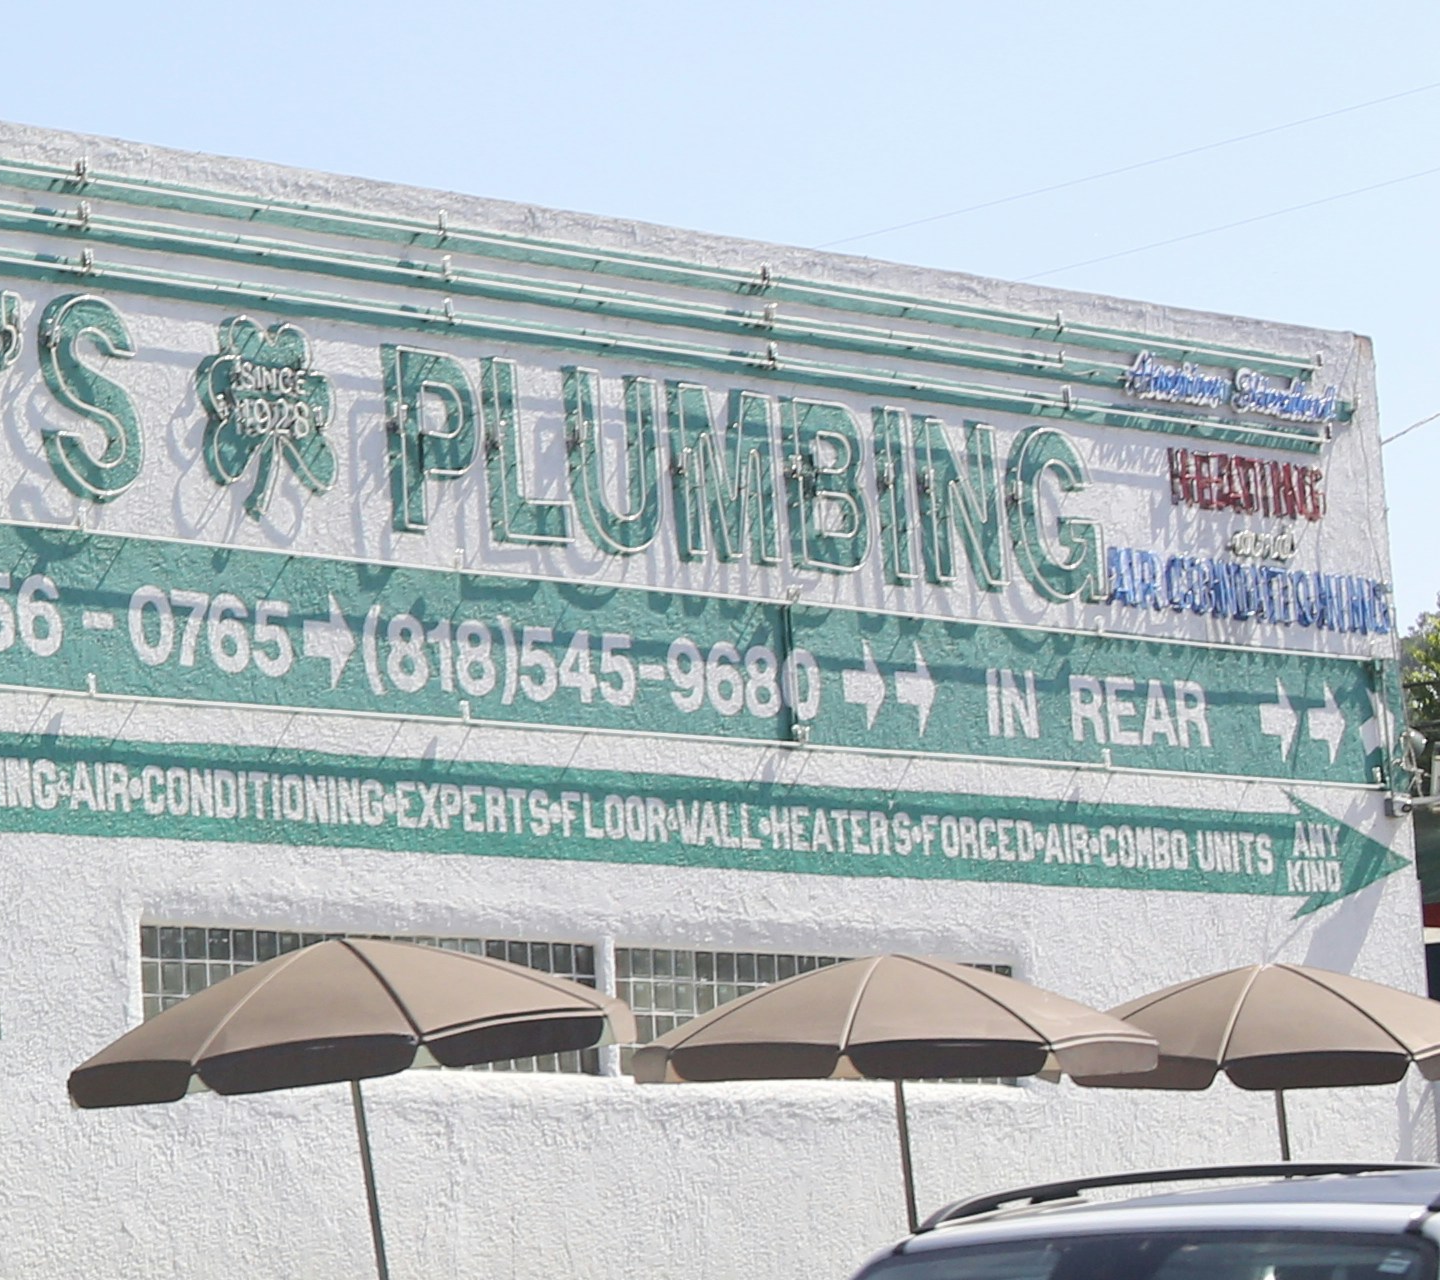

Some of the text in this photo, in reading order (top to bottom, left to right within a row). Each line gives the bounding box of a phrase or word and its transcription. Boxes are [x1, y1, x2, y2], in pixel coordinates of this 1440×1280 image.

[240, 361, 310, 396] SINCE
[237, 397, 310, 439] 1928
[380, 343, 1110, 606] PLUMBING
[985, 667, 1040, 740] IN
[1067, 673, 1213, 748] REAR
[141, 762, 384, 827] CONDITIONING
[396, 780, 551, 838] EXPERTS
[558, 794, 664, 844] FLOOR
[678, 800, 763, 850] WALL
[770, 805, 913, 856] HEATERS
[922, 815, 1036, 862] FORCED
[1044, 819, 1093, 866] AIR
[1098, 822, 1189, 872] COMBO
[1196, 827, 1273, 877] UNITS
[1292, 820, 1341, 859] ANY
[1285, 858, 1344, 894] KIND
